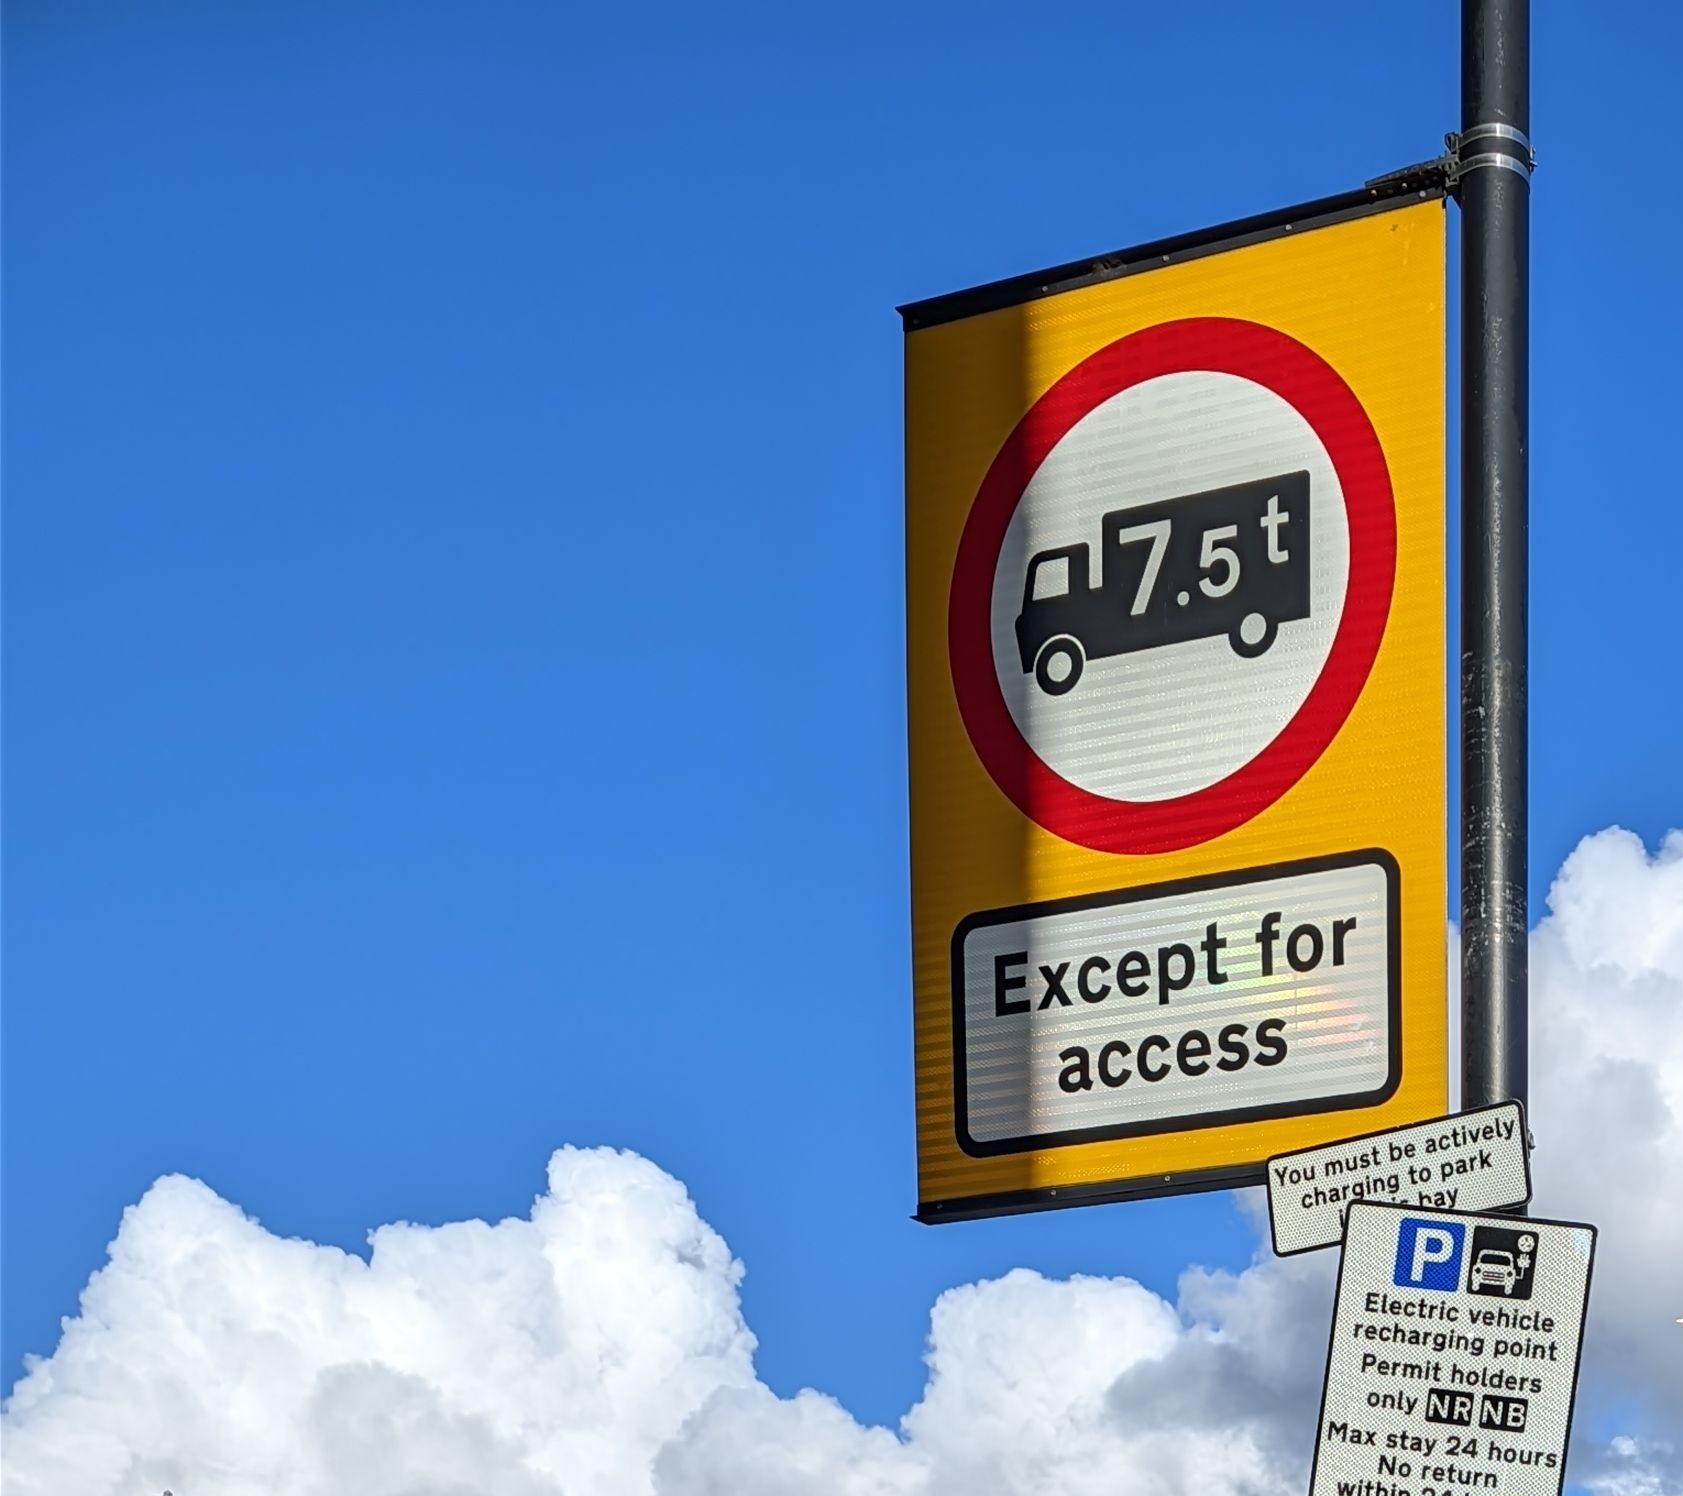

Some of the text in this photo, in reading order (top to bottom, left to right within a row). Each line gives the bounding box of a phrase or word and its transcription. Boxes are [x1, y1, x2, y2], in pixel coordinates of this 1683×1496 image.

[994, 911, 1357, 1017] Except for
[1057, 1017, 1288, 1094] access
[1274, 1117, 1516, 1187] You must be actively
[1301, 1149, 1493, 1209] charging to park
[1409, 1226, 1455, 1282] P
[1364, 1292, 1555, 1334] Electric vehicle
[1353, 1322, 1558, 1362] recharging point
[1361, 1353, 1543, 1394] Permit holders
[1366, 1390, 1526, 1428] only NR NB
[1327, 1421, 1558, 1468] Max stay 24 hours
[1377, 1454, 1499, 1489] No return
